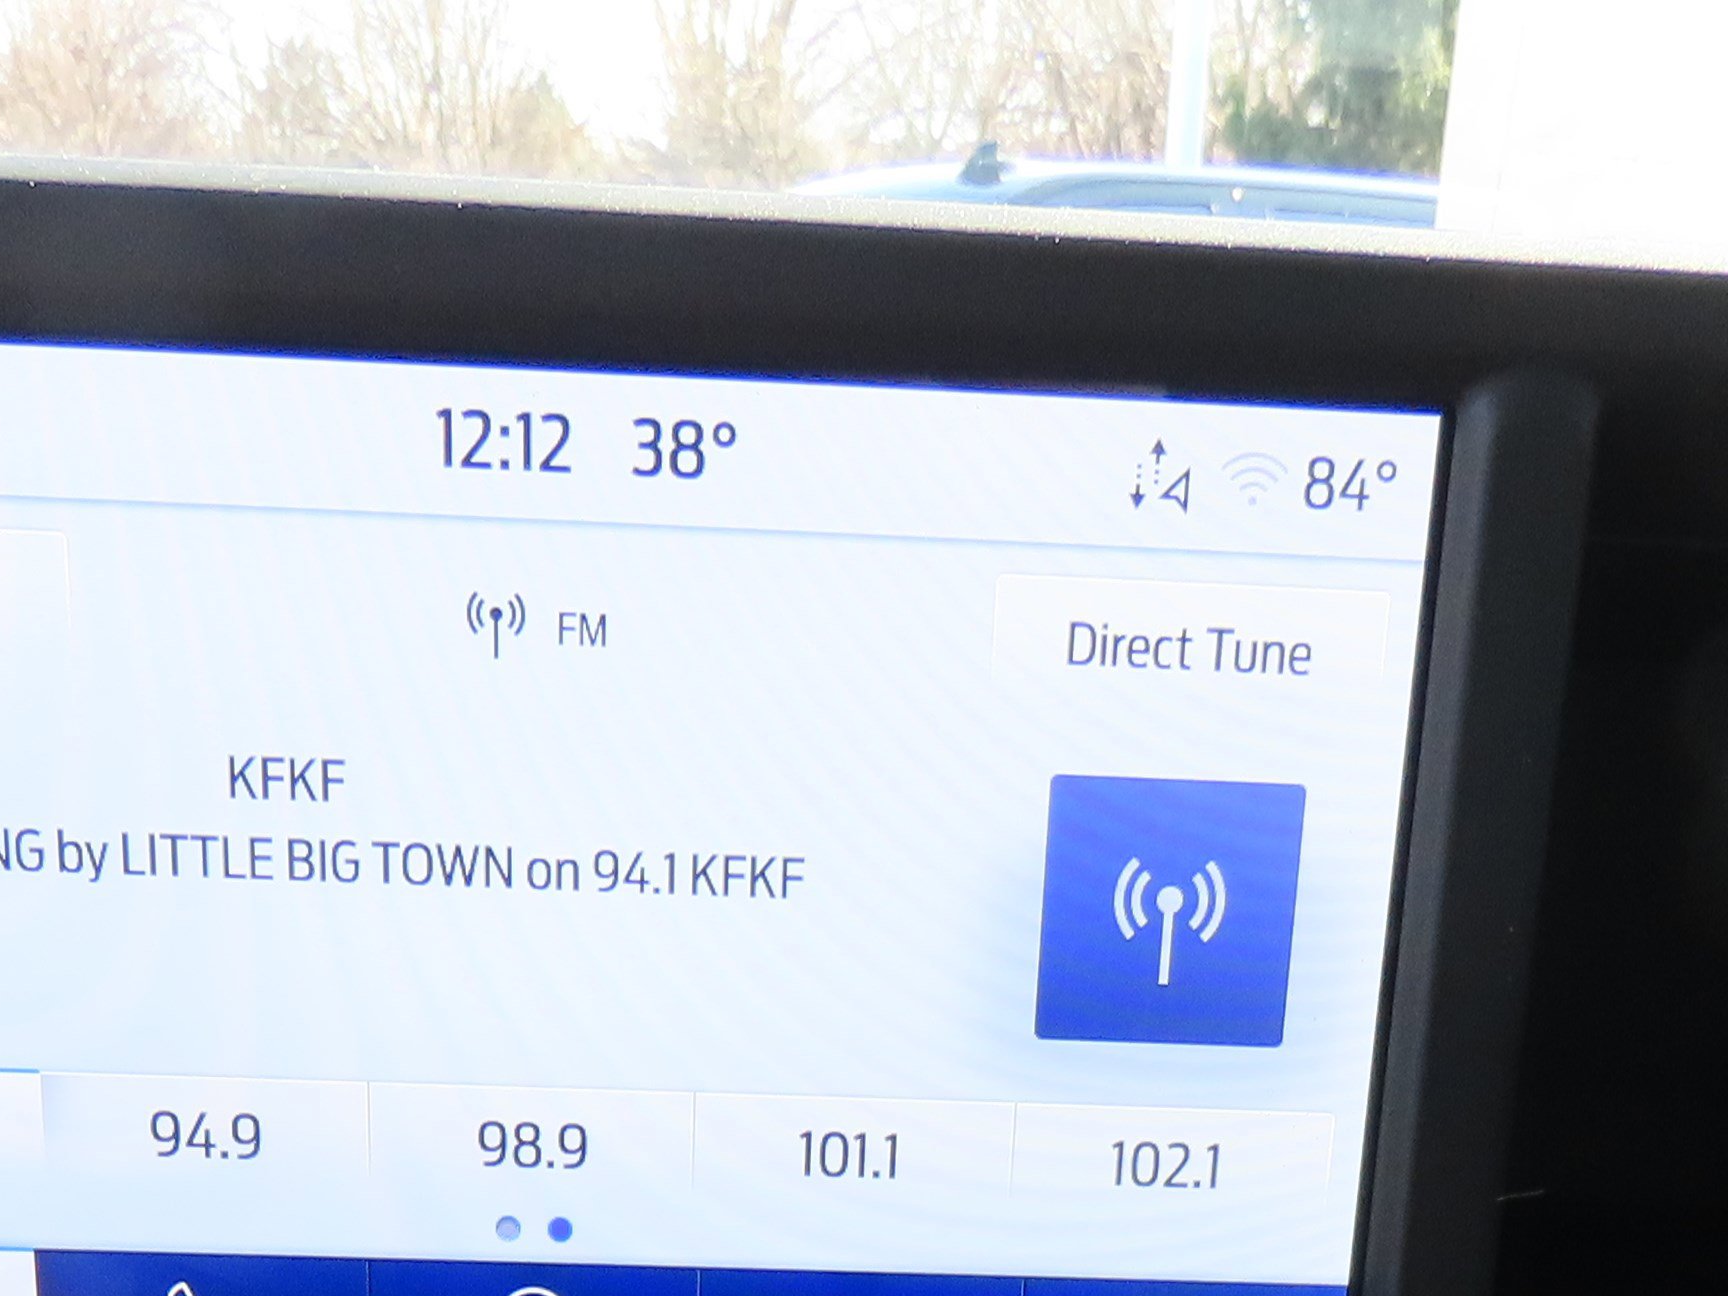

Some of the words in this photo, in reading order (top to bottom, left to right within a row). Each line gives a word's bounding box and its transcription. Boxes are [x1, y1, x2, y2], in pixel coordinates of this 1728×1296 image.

[436, 408, 571, 473] 12:12
[558, 612, 607, 647] FM
[1067, 621, 1192, 671] Direct
[1207, 627, 1312, 676] Tune
[229, 755, 345, 802] KFKF
[57, 828, 108, 883] by
[121, 833, 273, 880] LITTLE
[287, 839, 360, 883] BIG
[372, 841, 513, 889] TOWN
[526, 858, 580, 891] on
[593, 850, 676, 895] 94.1
[691, 854, 805, 899] KFKF
[150, 1110, 261, 1160] 94.9
[478, 1121, 588, 1169] 98.9
[800, 1131, 898, 1179] 101.1
[1112, 1141, 1220, 1189] 102.1
